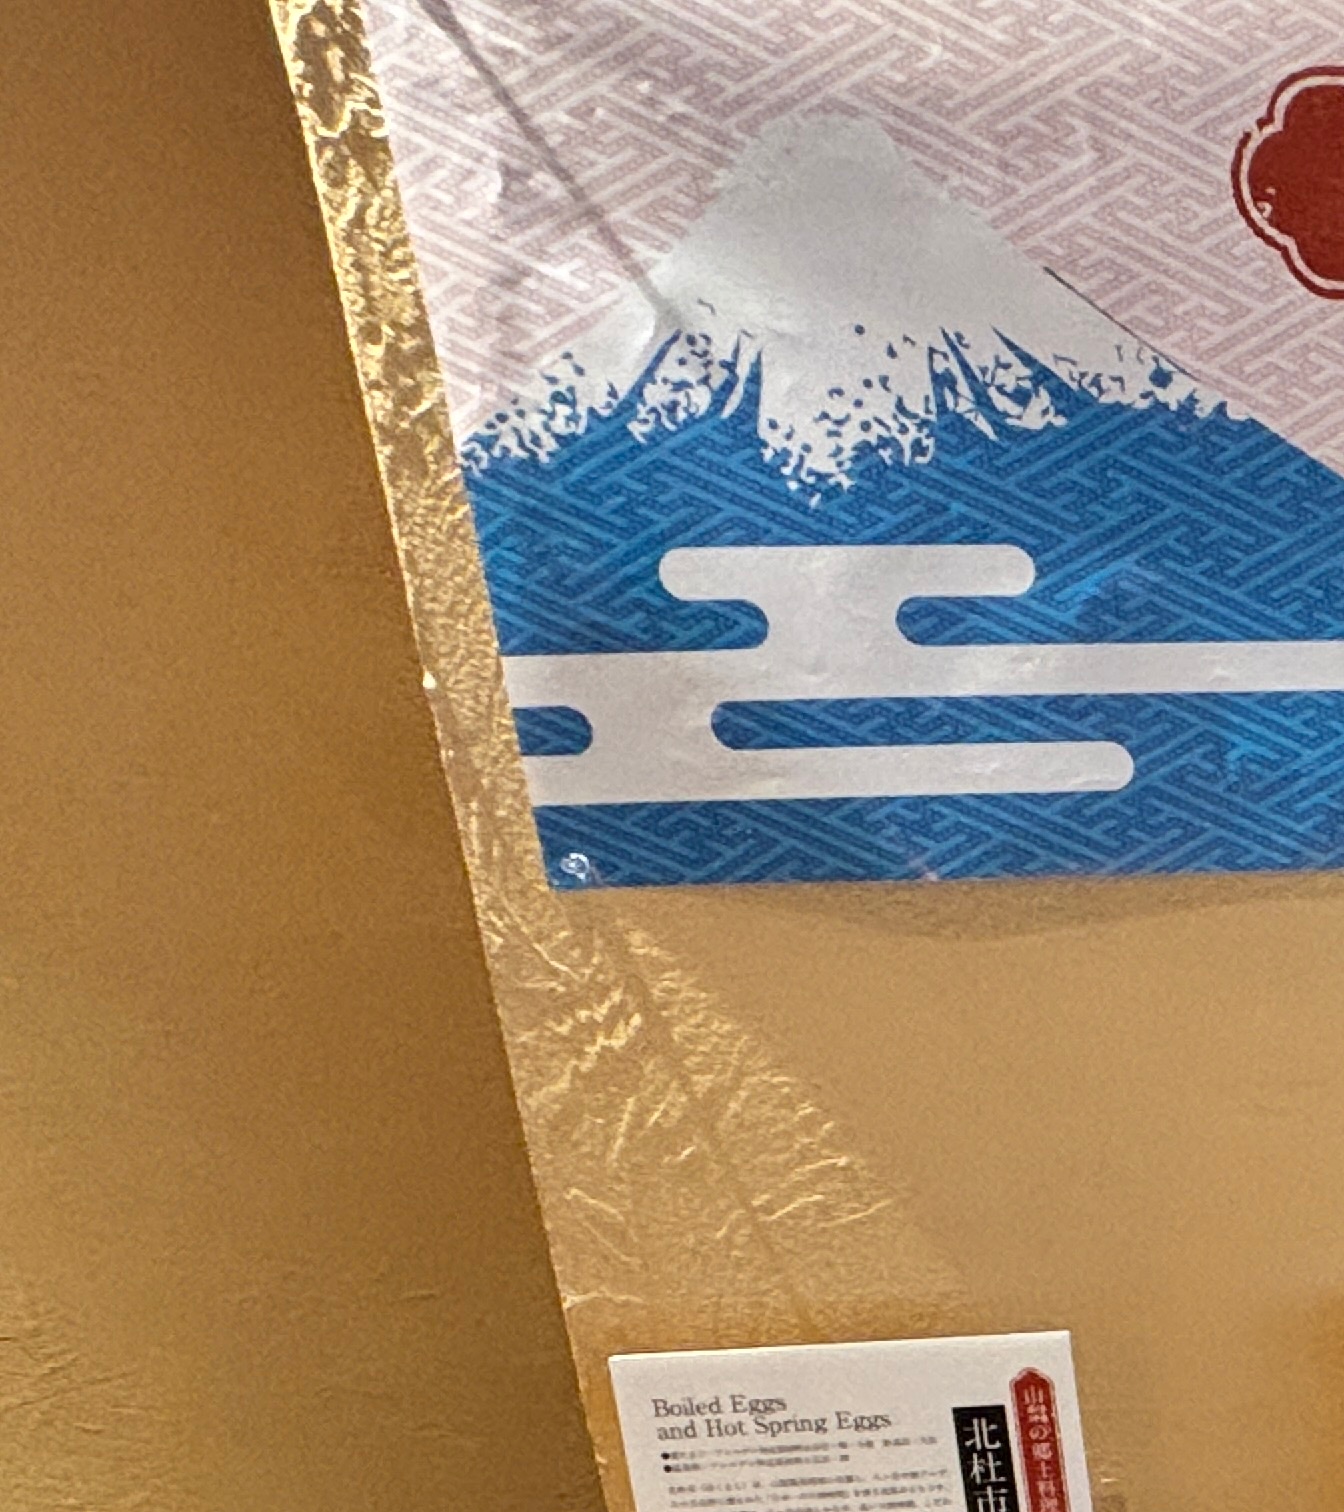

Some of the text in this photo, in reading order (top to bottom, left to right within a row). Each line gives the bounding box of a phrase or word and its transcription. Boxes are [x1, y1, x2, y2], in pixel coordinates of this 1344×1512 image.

[652, 1394, 787, 1418] Boiled Eggs
[657, 1410, 892, 1441] and Hot Spring Eggs
